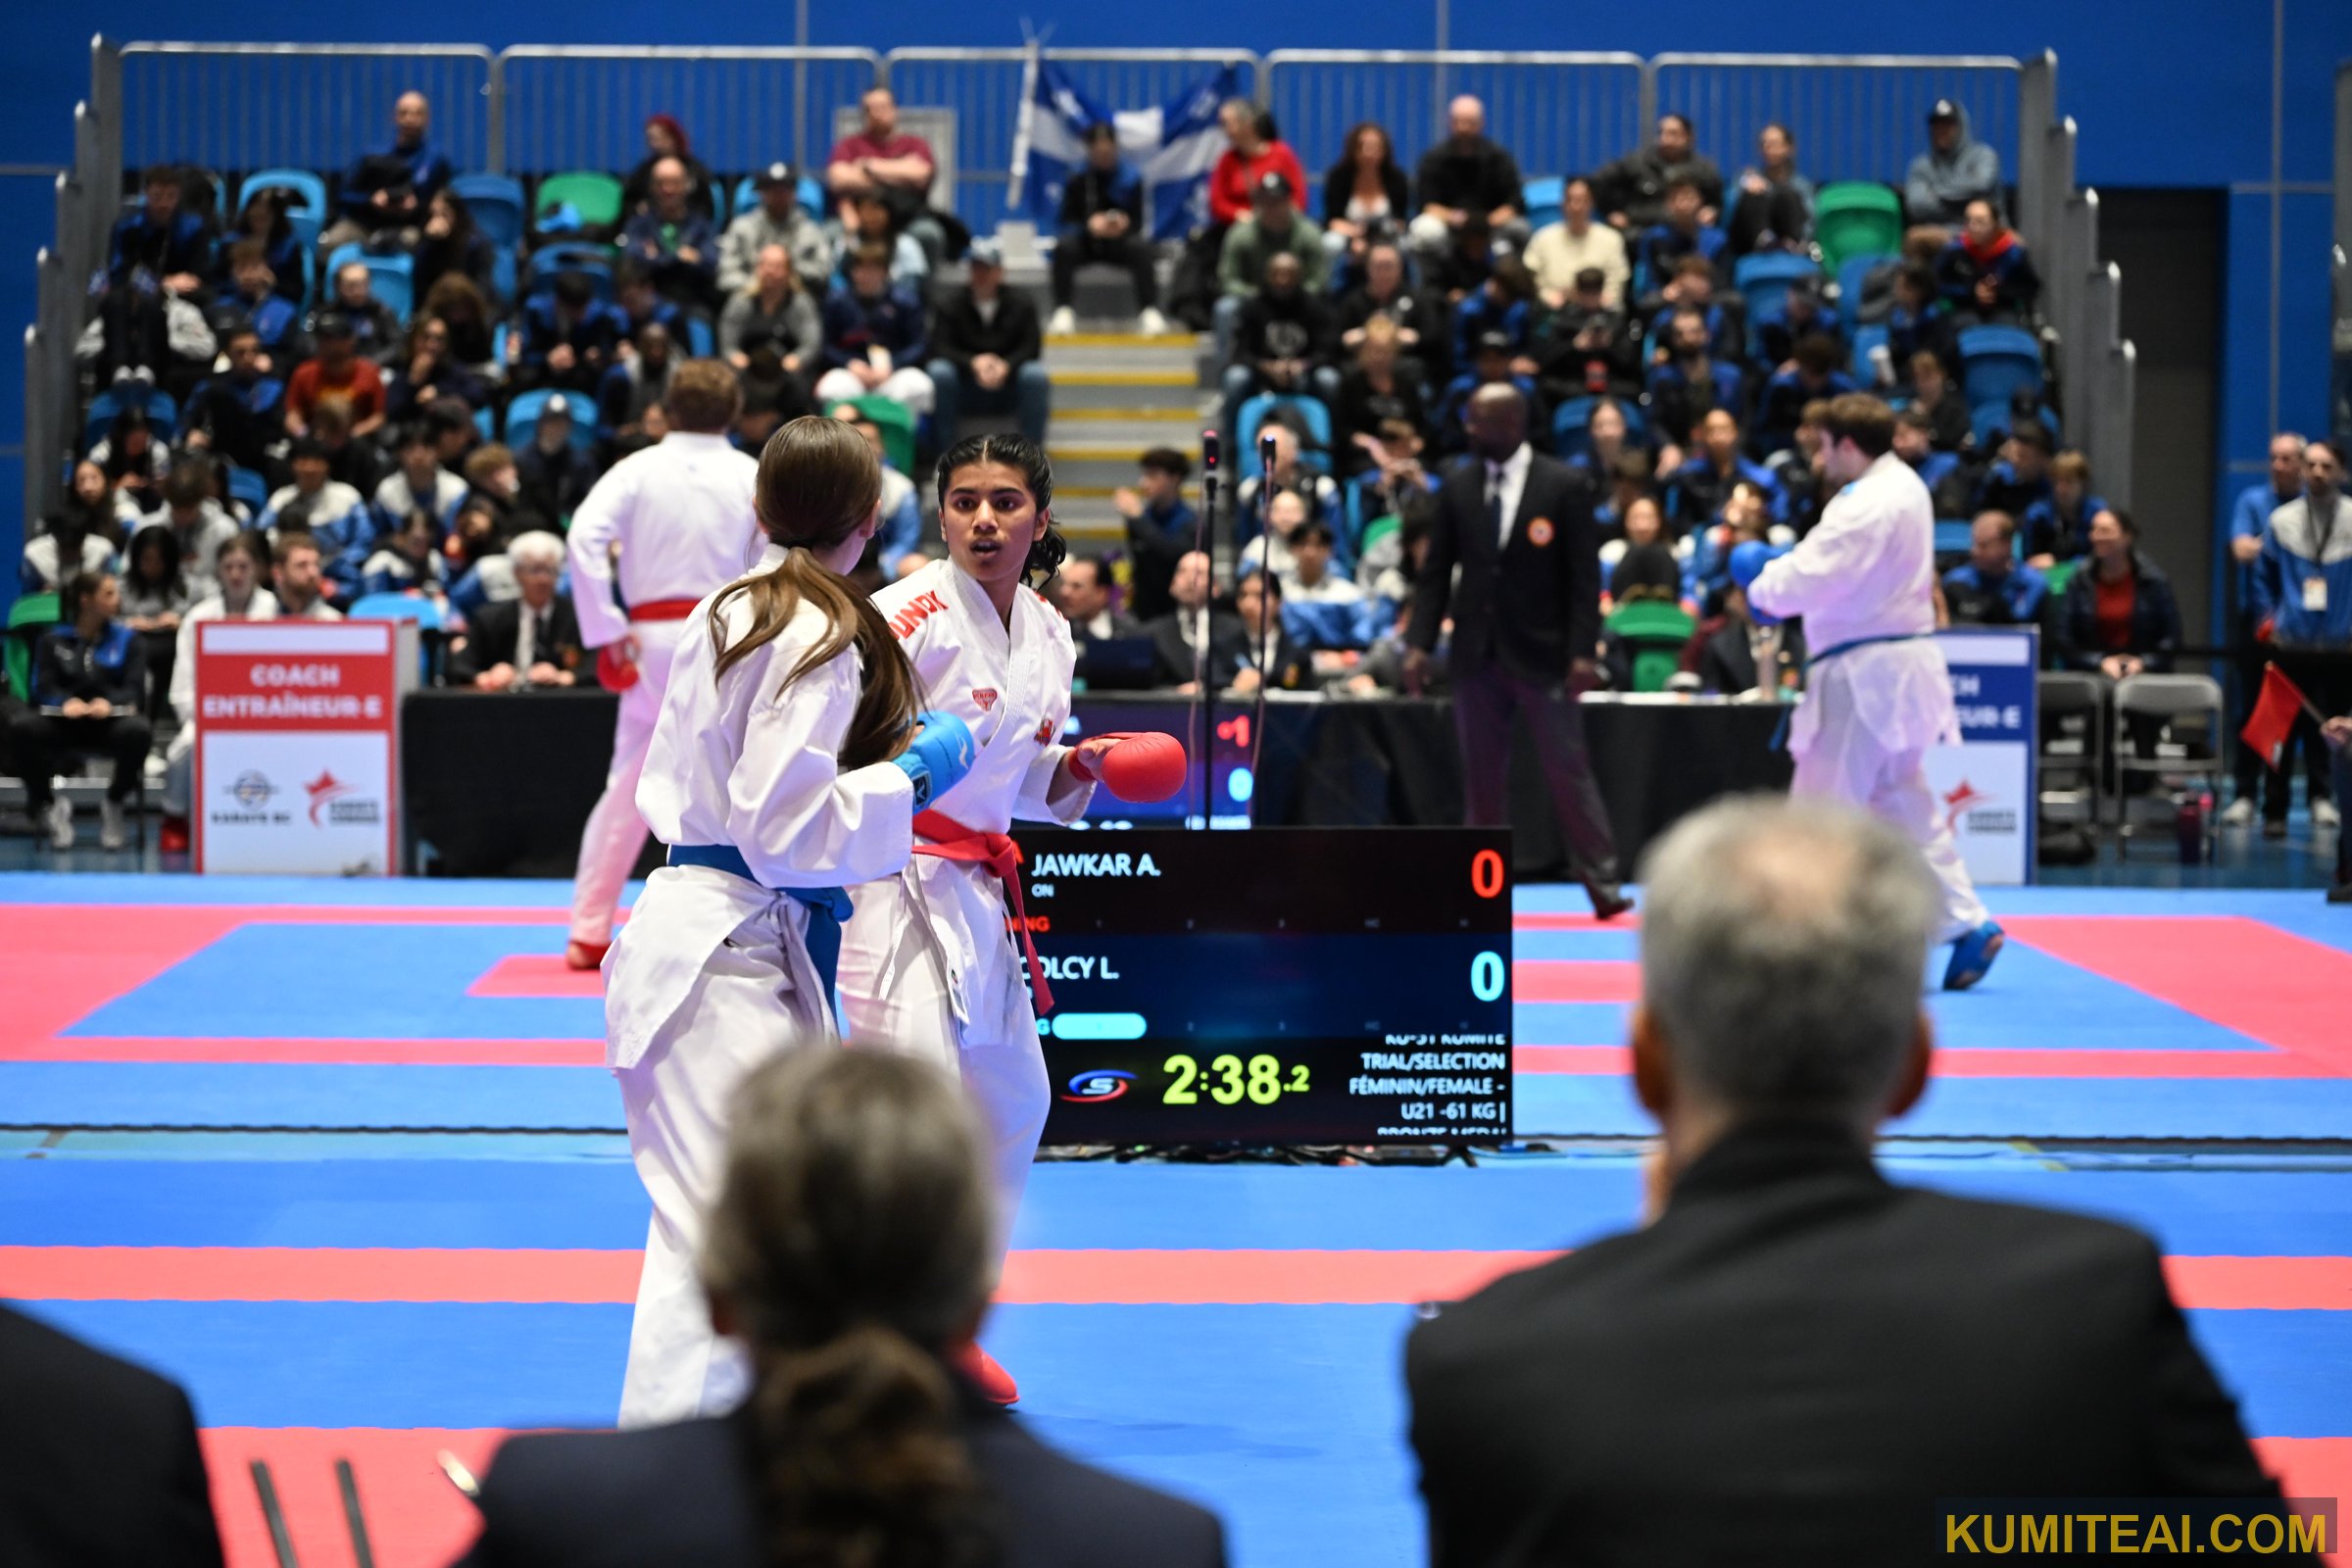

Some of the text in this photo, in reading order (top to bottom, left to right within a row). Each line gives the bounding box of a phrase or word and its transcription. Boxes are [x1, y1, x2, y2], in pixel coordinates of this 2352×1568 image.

[250, 662, 341, 687] COACH
[1031, 854, 1162, 877] JAWKAR A.
[1472, 849, 1504, 899] 0
[1031, 883, 1055, 898] ON
[1100, 956, 1120, 980] L.
[1471, 951, 1505, 1002] 0
[1360, 1053, 1506, 1071] TRIAL/SELECTION
[1348, 1074, 1494, 1096] FÉMININ/FEMALE
[1400, 1102, 1435, 1120] U21
[1439, 1102, 1467, 1120] -61
[1471, 1102, 1496, 1120] KG
